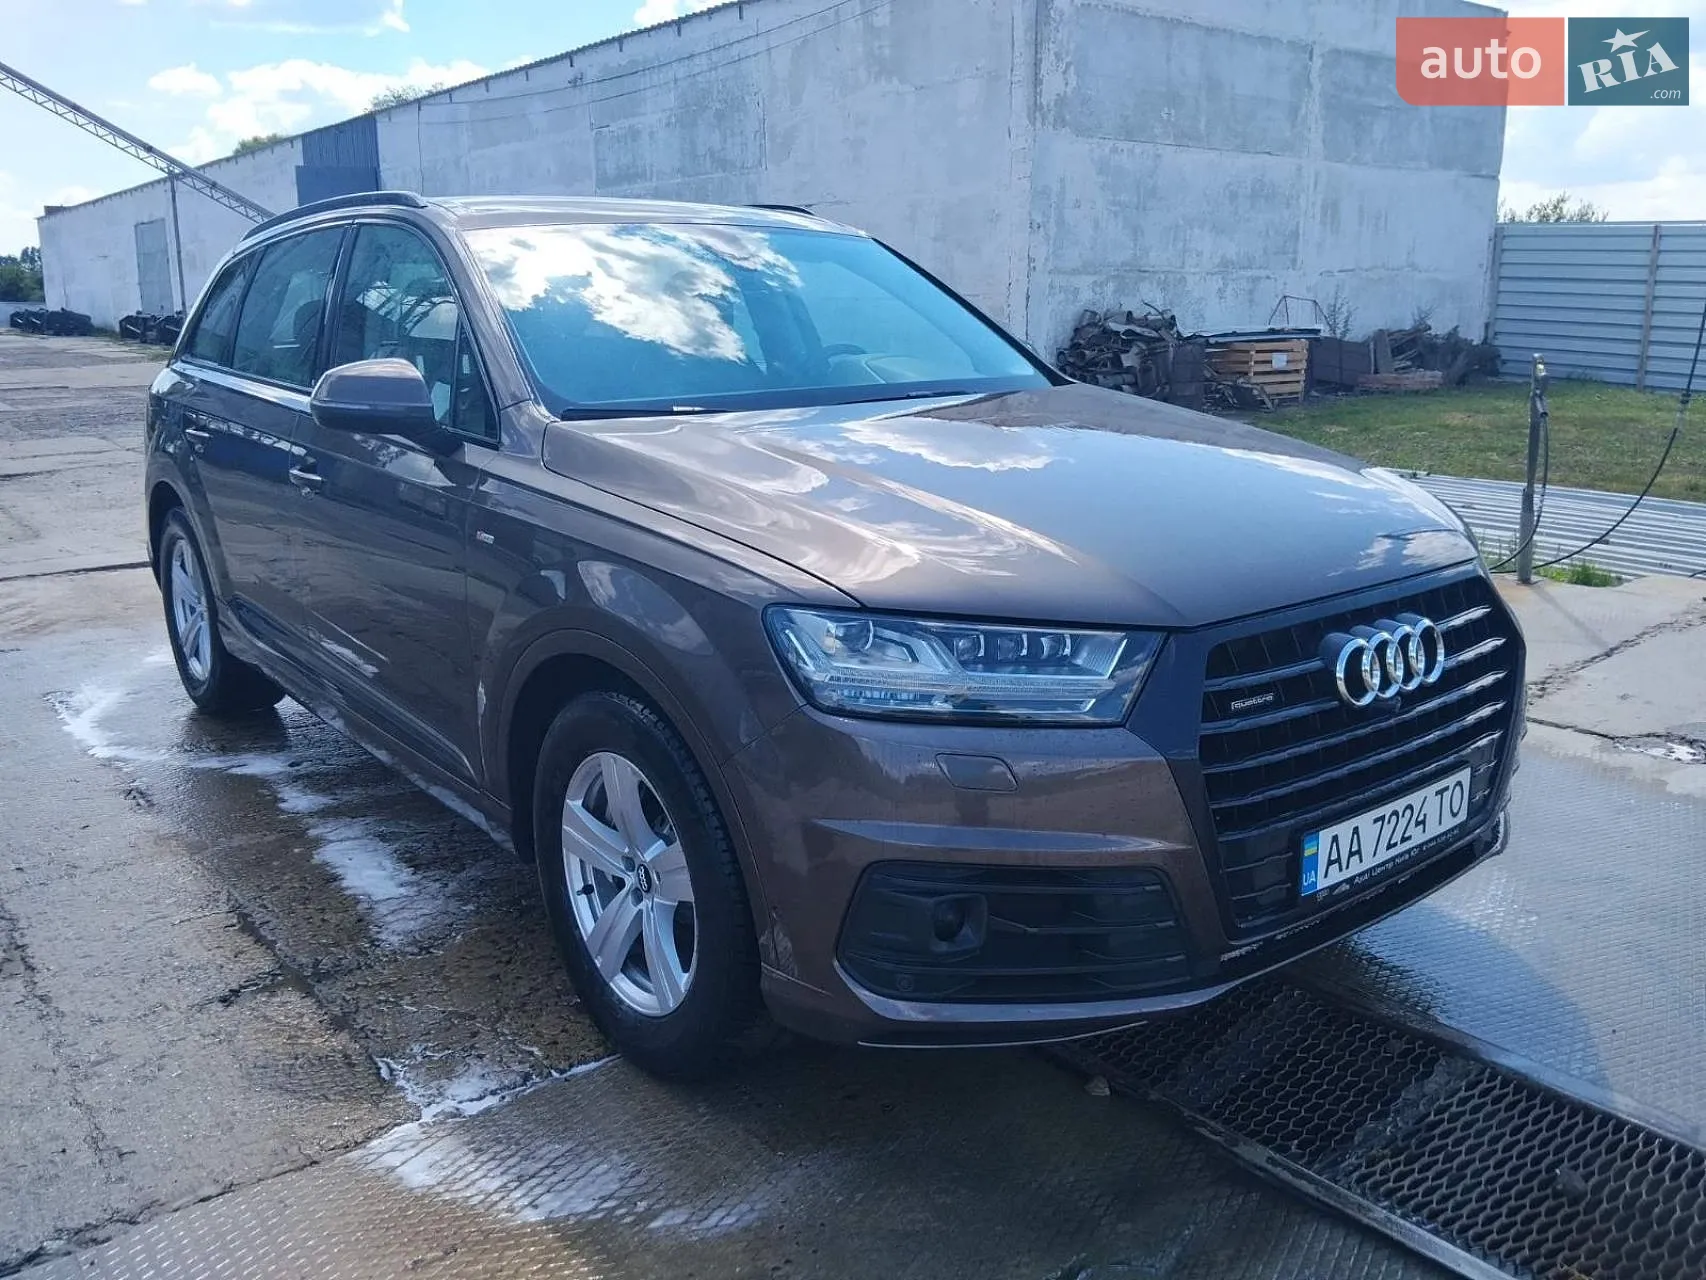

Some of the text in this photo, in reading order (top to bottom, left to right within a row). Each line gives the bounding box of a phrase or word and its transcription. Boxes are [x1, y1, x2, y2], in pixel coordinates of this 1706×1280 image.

[1323, 825, 1364, 879] AA
[1372, 795, 1428, 858] 7224
[1434, 780, 1464, 826] TO
[1302, 869, 1316, 886] UA
